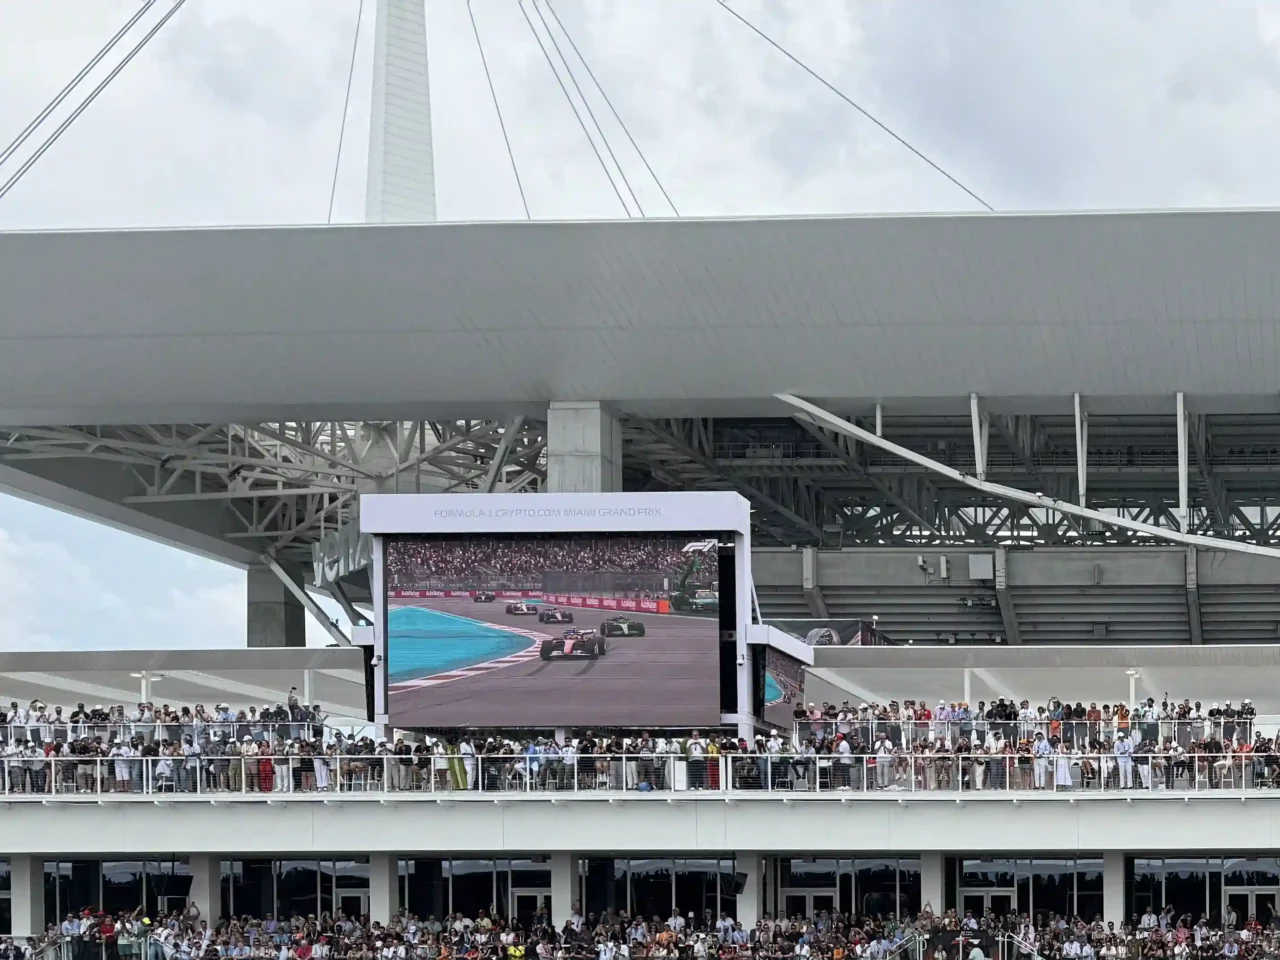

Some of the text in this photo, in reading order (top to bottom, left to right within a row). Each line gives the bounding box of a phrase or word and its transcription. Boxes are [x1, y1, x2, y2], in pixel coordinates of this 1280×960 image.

[434, 509, 486, 518] FORMULA
[488, 509, 493, 518] 1
[563, 508, 596, 517] MIAMI
[598, 507, 636, 517] GRAND
[637, 507, 662, 517] PRIX
